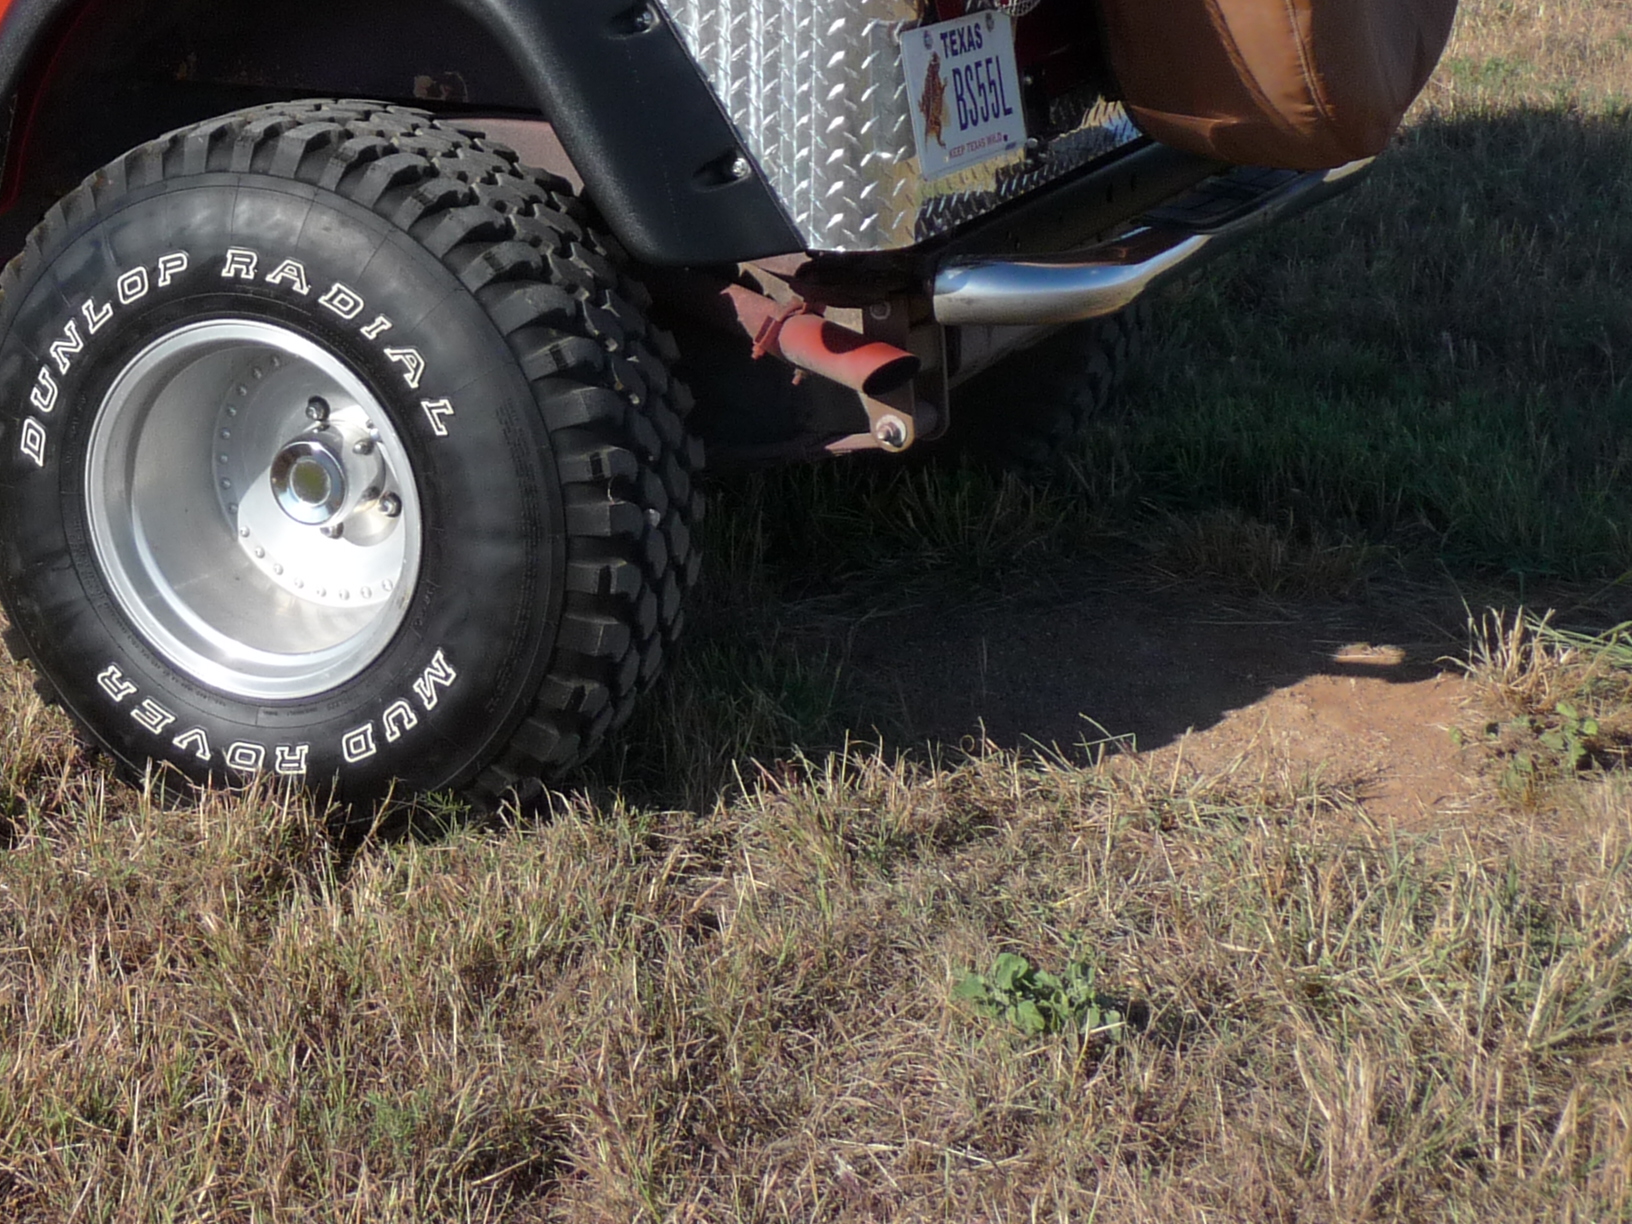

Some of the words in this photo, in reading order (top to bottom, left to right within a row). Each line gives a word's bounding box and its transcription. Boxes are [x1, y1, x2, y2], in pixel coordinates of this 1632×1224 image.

[940, 22, 983, 59] TEXAS
[952, 55, 1013, 131] BS55L
[949, 144, 965, 158] KEEP
[966, 137, 986, 152] TEXAS
[986, 132, 1003, 146] WILD
[20, 249, 189, 467] DUNLOP
[221, 246, 455, 437] RADIAL
[97, 662, 311, 776] ROVER
[341, 648, 458, 763] MUD
